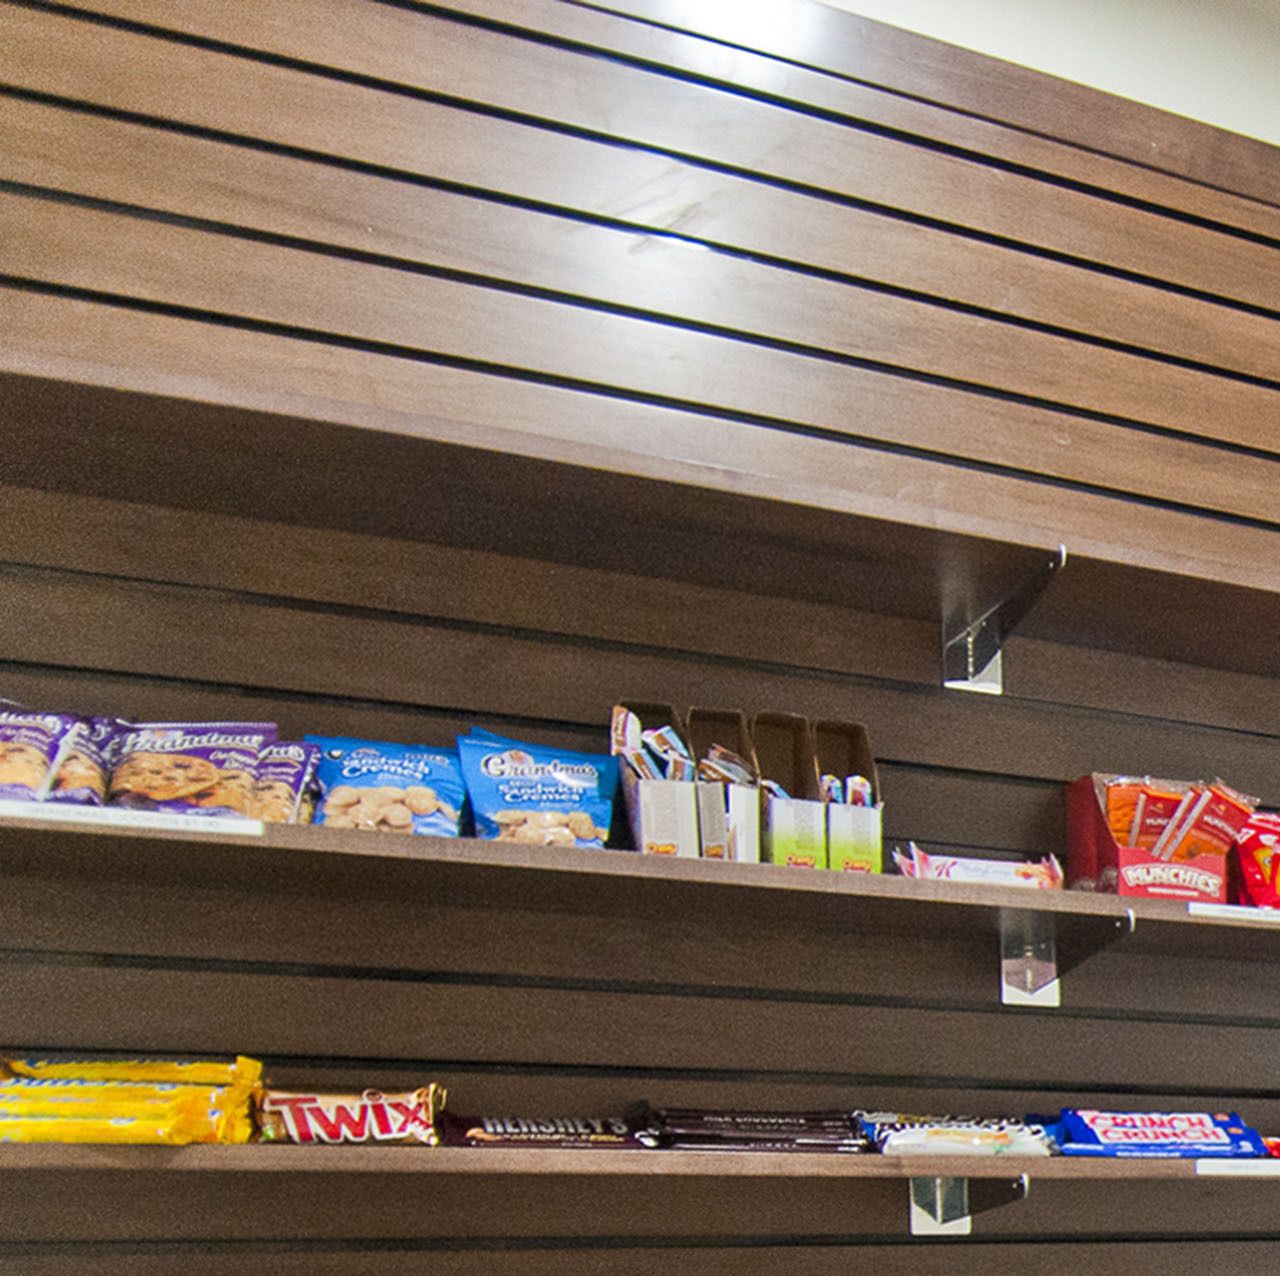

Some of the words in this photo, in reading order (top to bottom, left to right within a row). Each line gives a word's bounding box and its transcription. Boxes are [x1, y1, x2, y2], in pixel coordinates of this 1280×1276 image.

[1122, 865, 1222, 897] MUNCHIES
[268, 1089, 434, 1143] TWIX
[1089, 1115, 1207, 1129] CRUNCH
[1101, 1129, 1221, 1141] CRUNCH
